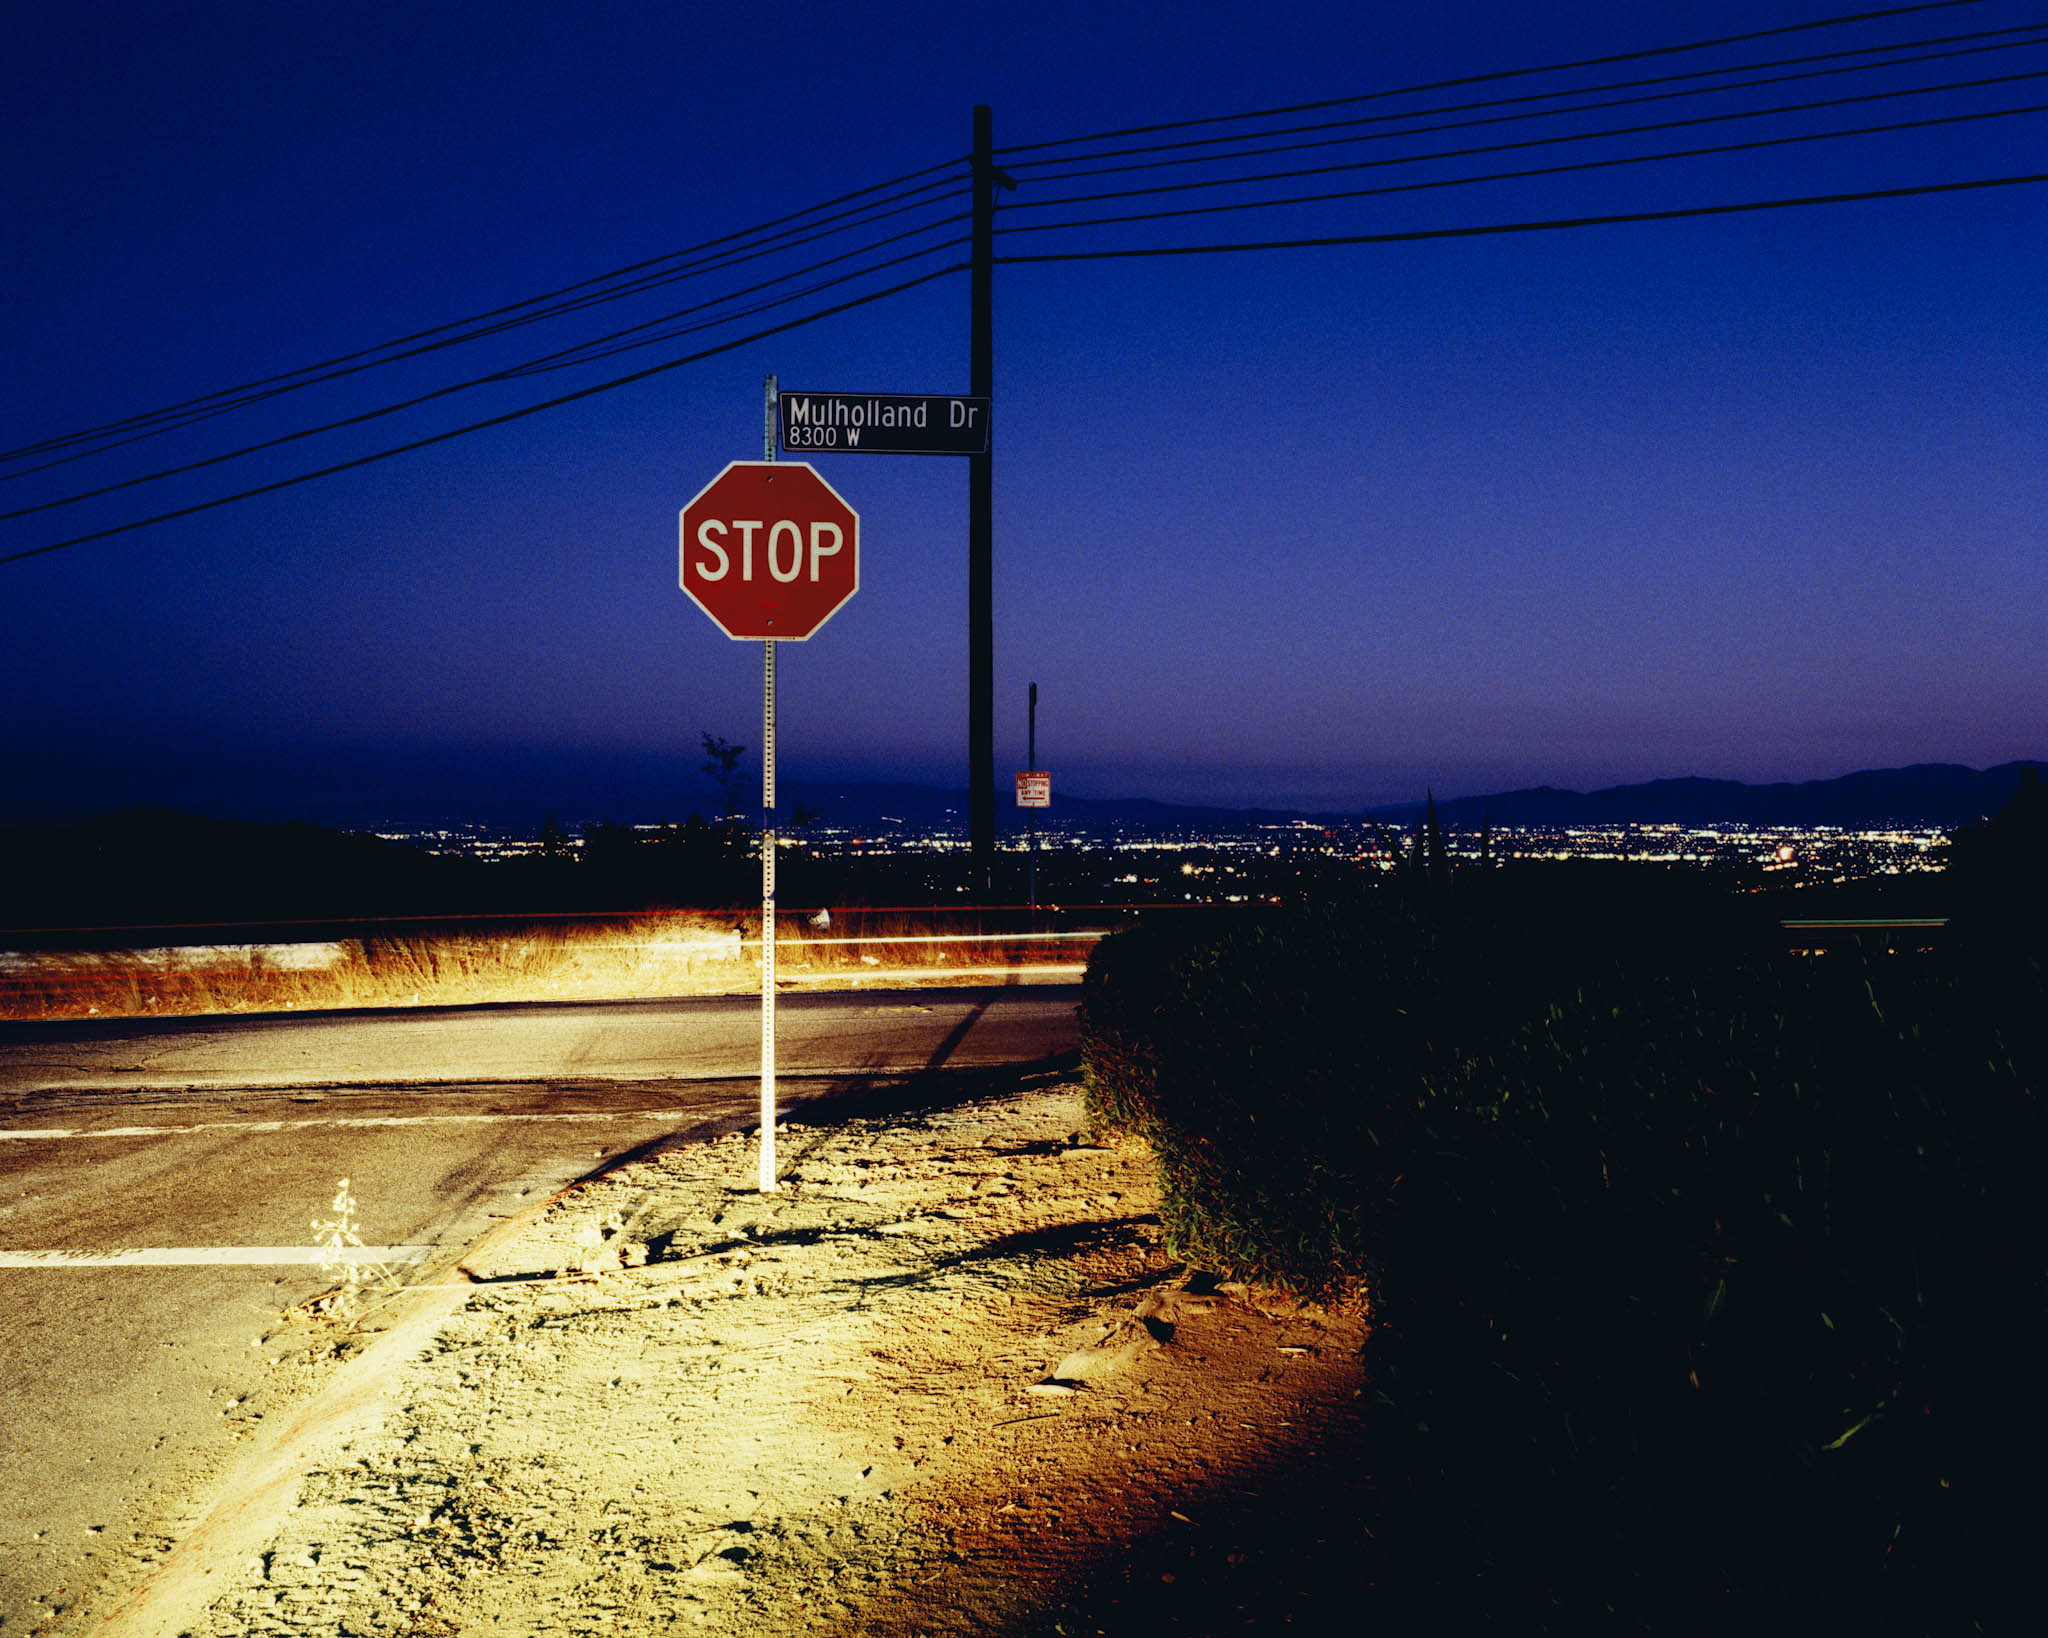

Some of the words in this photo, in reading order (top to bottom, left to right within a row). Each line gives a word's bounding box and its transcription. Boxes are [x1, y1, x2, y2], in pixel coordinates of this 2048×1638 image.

[790, 397, 927, 428] Mulholland
[950, 400, 978, 428] Dr
[789, 426, 837, 446] 8300
[846, 428, 861, 447] W
[695, 519, 844, 583] STOP
